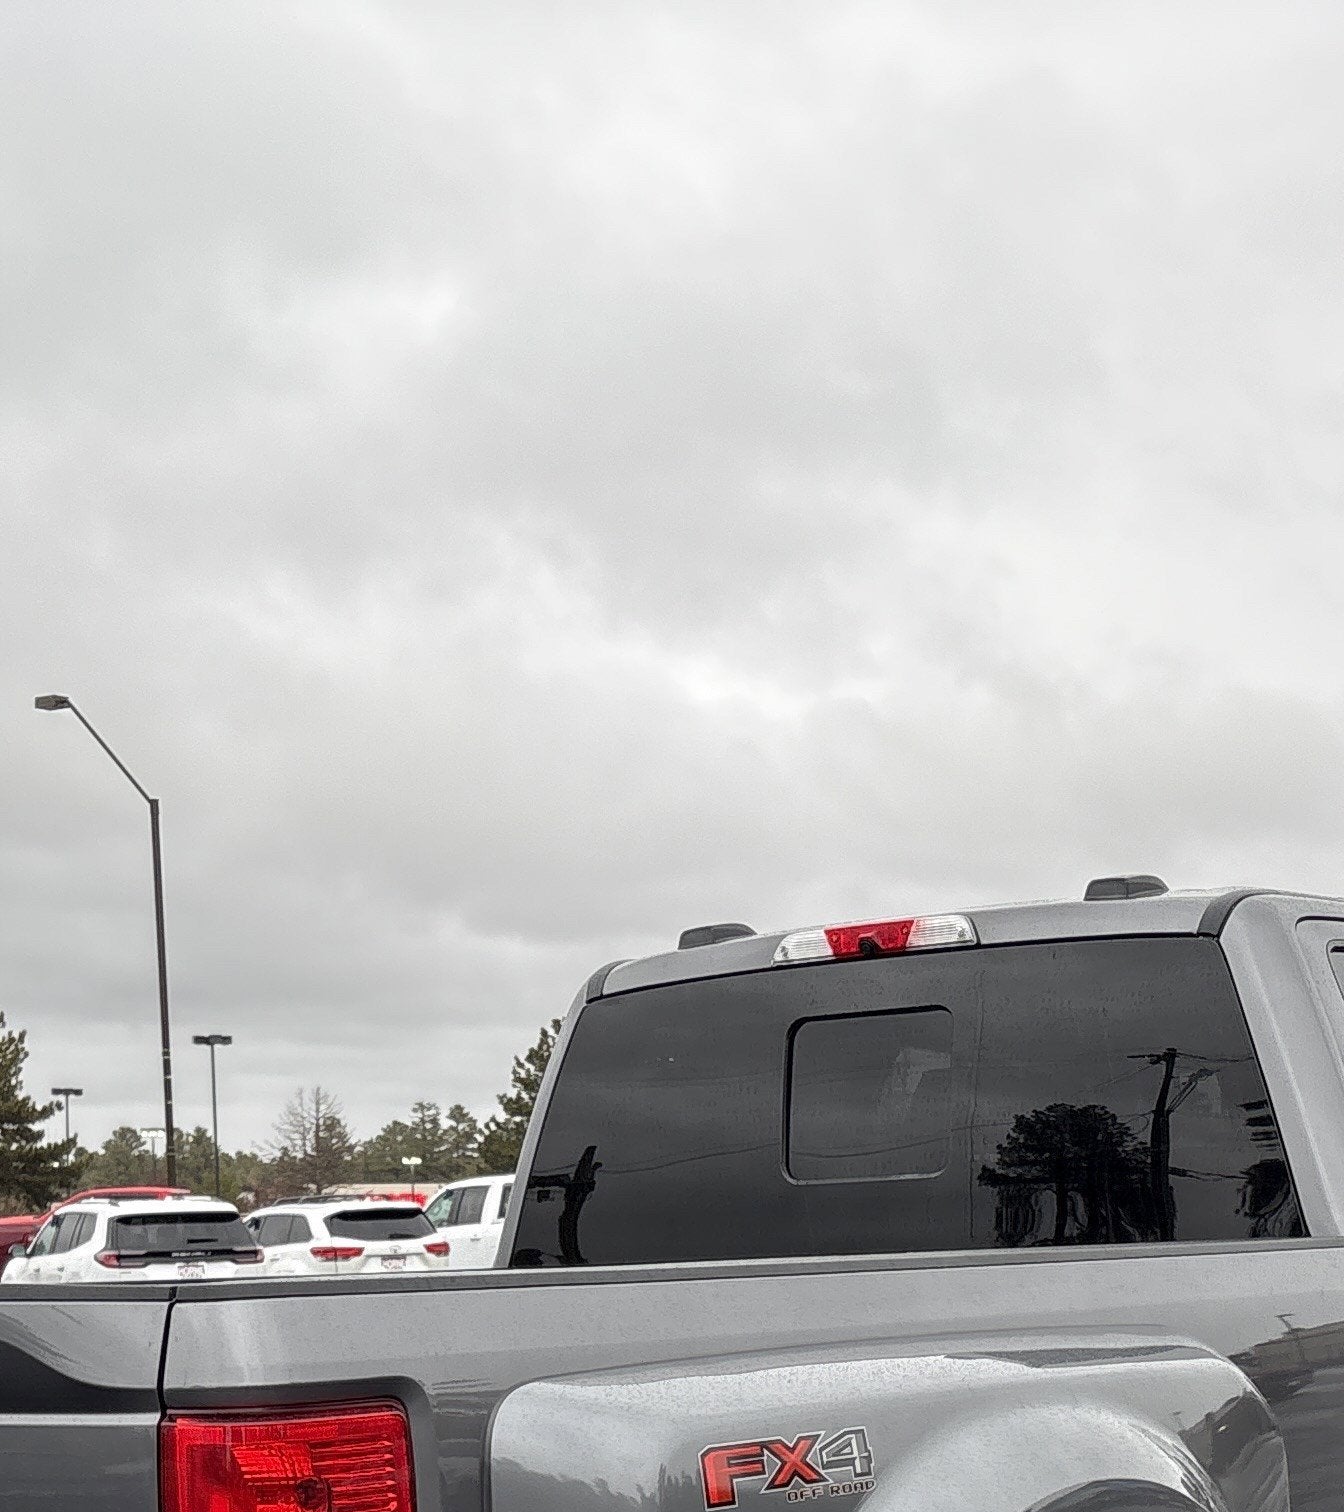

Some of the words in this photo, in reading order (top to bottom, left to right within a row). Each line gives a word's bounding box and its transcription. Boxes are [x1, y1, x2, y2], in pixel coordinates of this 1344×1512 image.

[698, 1426, 875, 1511] FX4
[786, 1487, 823, 1503] OFF
[829, 1478, 876, 1497] ROAD
